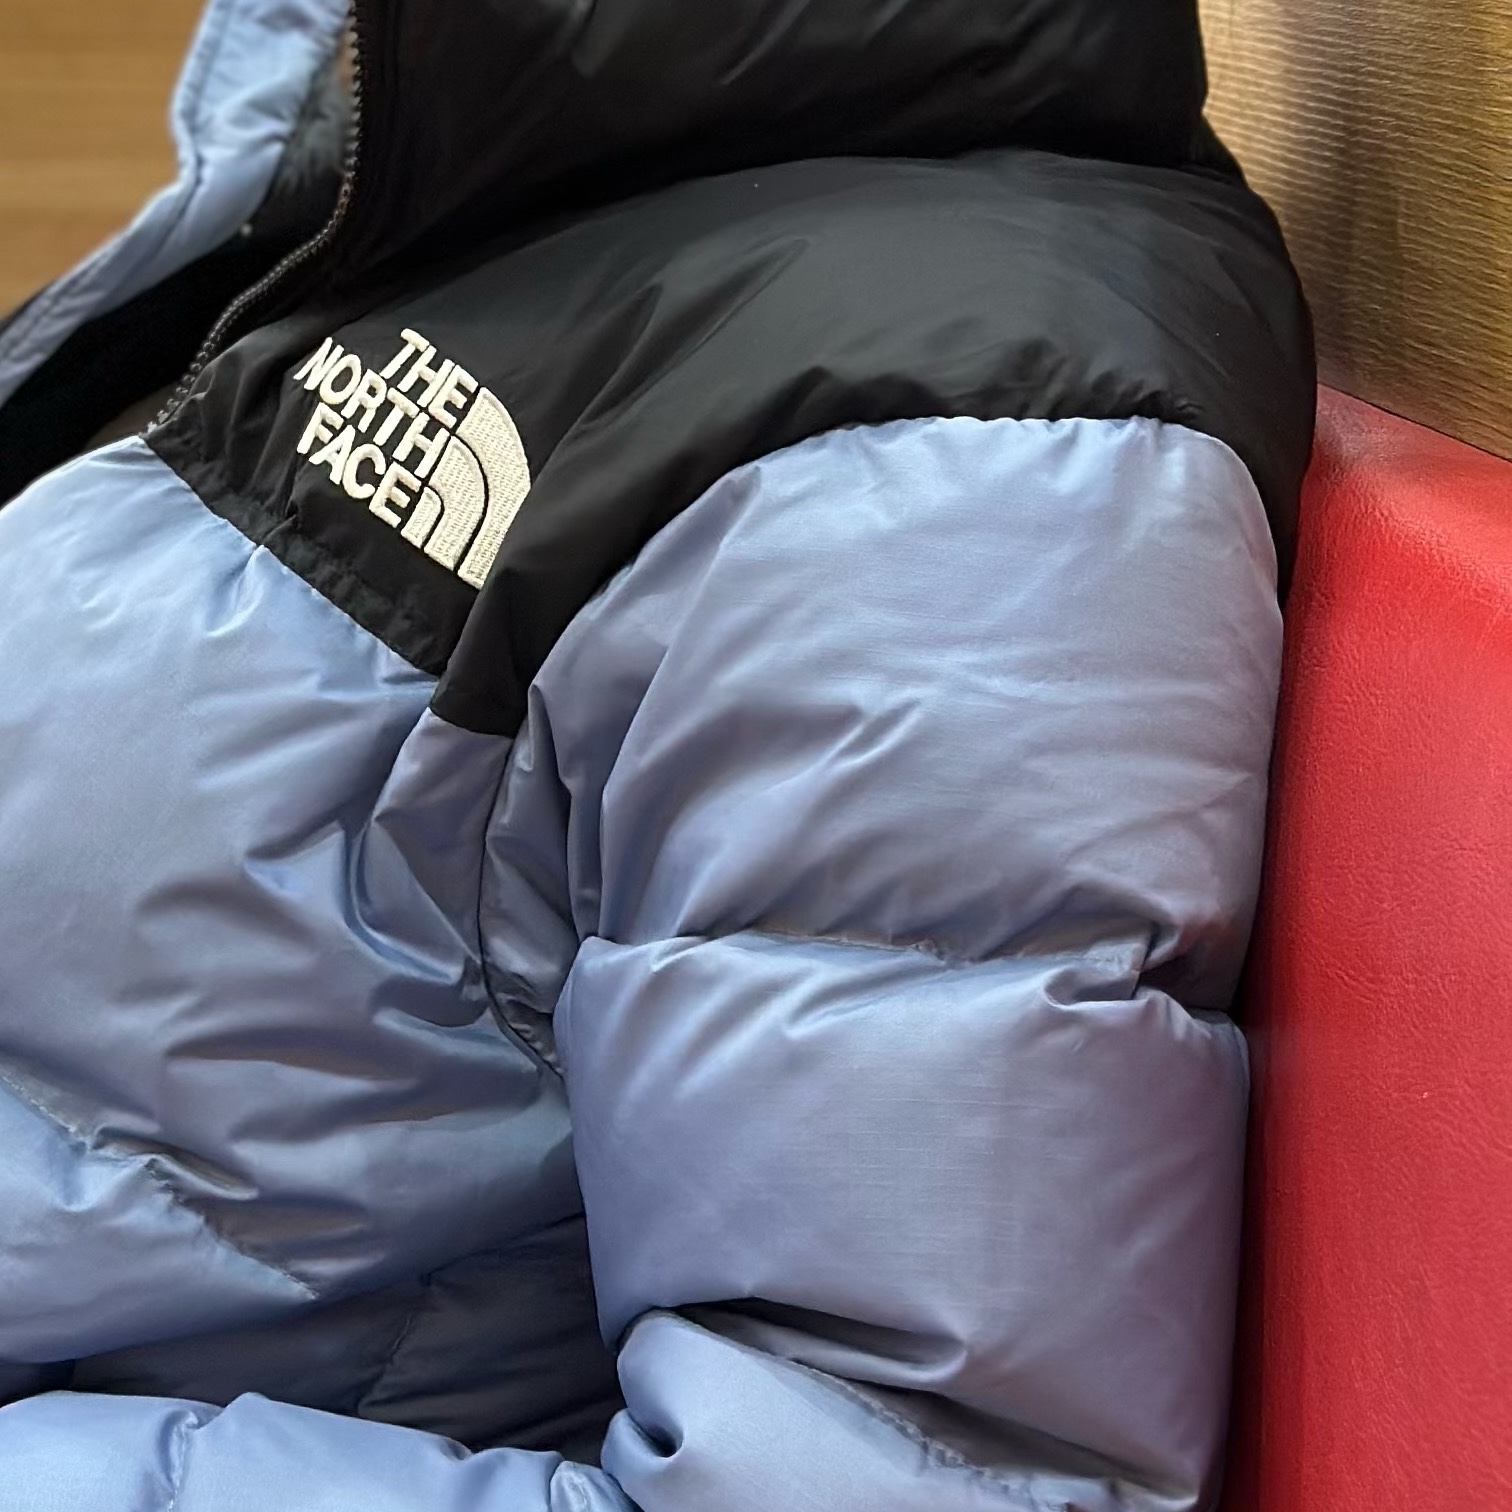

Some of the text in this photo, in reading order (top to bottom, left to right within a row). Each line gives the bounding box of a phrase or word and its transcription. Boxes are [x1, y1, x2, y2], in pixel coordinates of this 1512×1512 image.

[293, 337, 450, 479] NORTH
[381, 328, 478, 428] THE
[297, 402, 422, 528] FACE
